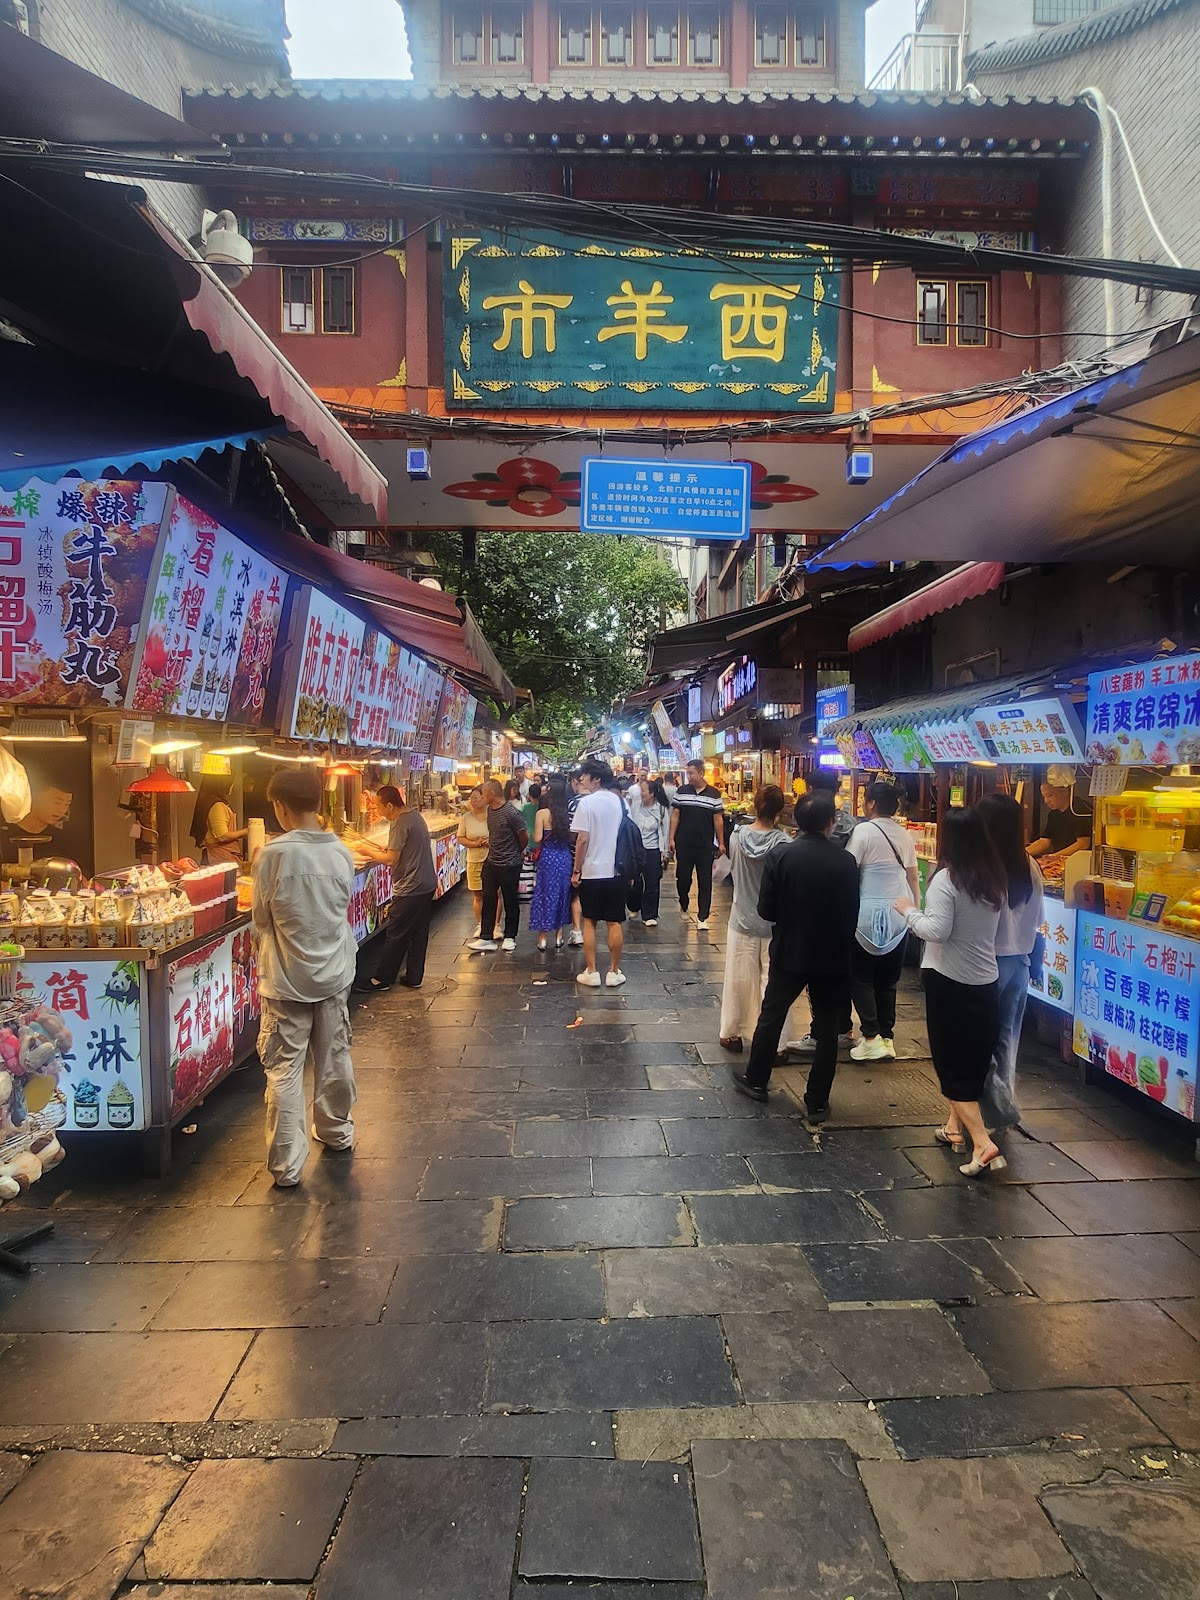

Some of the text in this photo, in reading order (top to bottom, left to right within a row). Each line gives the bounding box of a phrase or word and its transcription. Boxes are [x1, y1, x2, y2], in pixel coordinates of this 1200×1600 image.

[635, 471, 698, 483] 温馨提示
[37, 526, 54, 616] 冰镇酸梅汤
[60, 526, 122, 687] 牛筋丸
[165, 530, 217, 688] 石榴汁
[215, 550, 234, 617] 竹筒
[222, 556, 253, 661] 冰淇淋
[988, 717, 1049, 737] 纯手工辣条
[1093, 927, 1197, 985] 西瓜汁 石榴汁
[173, 972, 230, 1058] 石榴汁
[1104, 999, 1136, 1035] 酸梅汤
